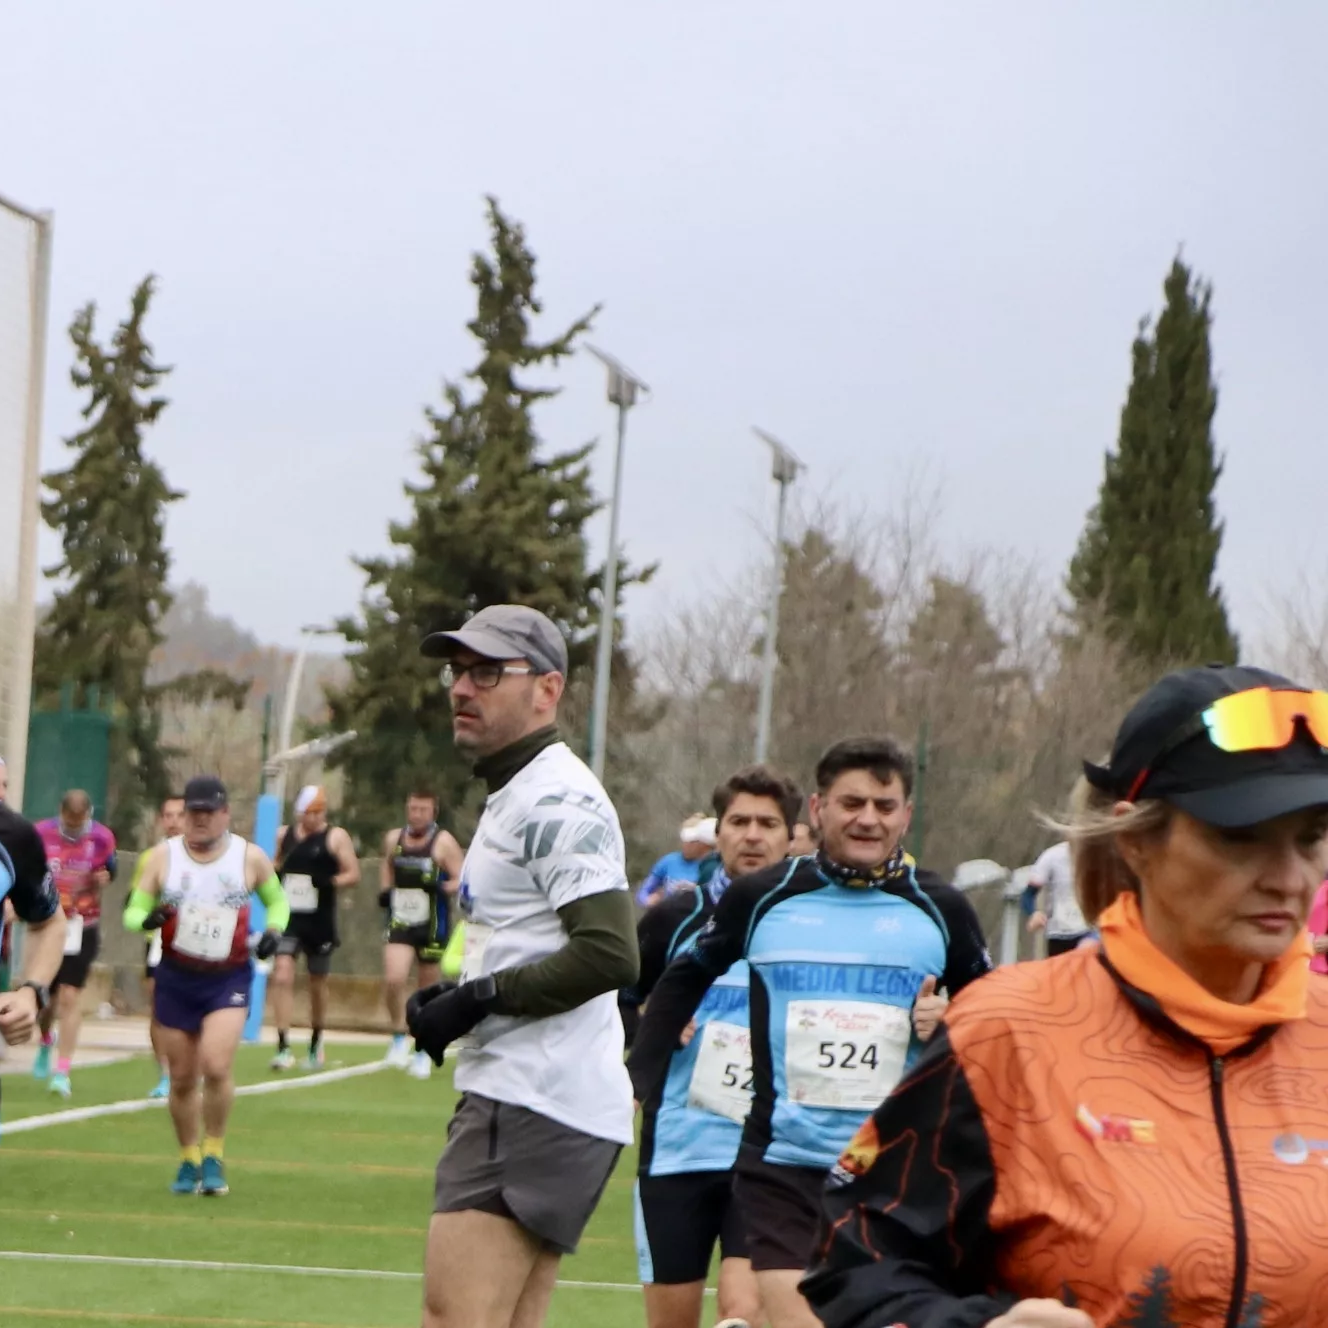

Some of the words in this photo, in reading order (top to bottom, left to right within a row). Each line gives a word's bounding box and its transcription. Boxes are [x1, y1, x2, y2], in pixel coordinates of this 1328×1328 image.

[772, 964, 846, 993] MEDIA
[817, 1040, 880, 1072] 524
[721, 1063, 755, 1092] 52
